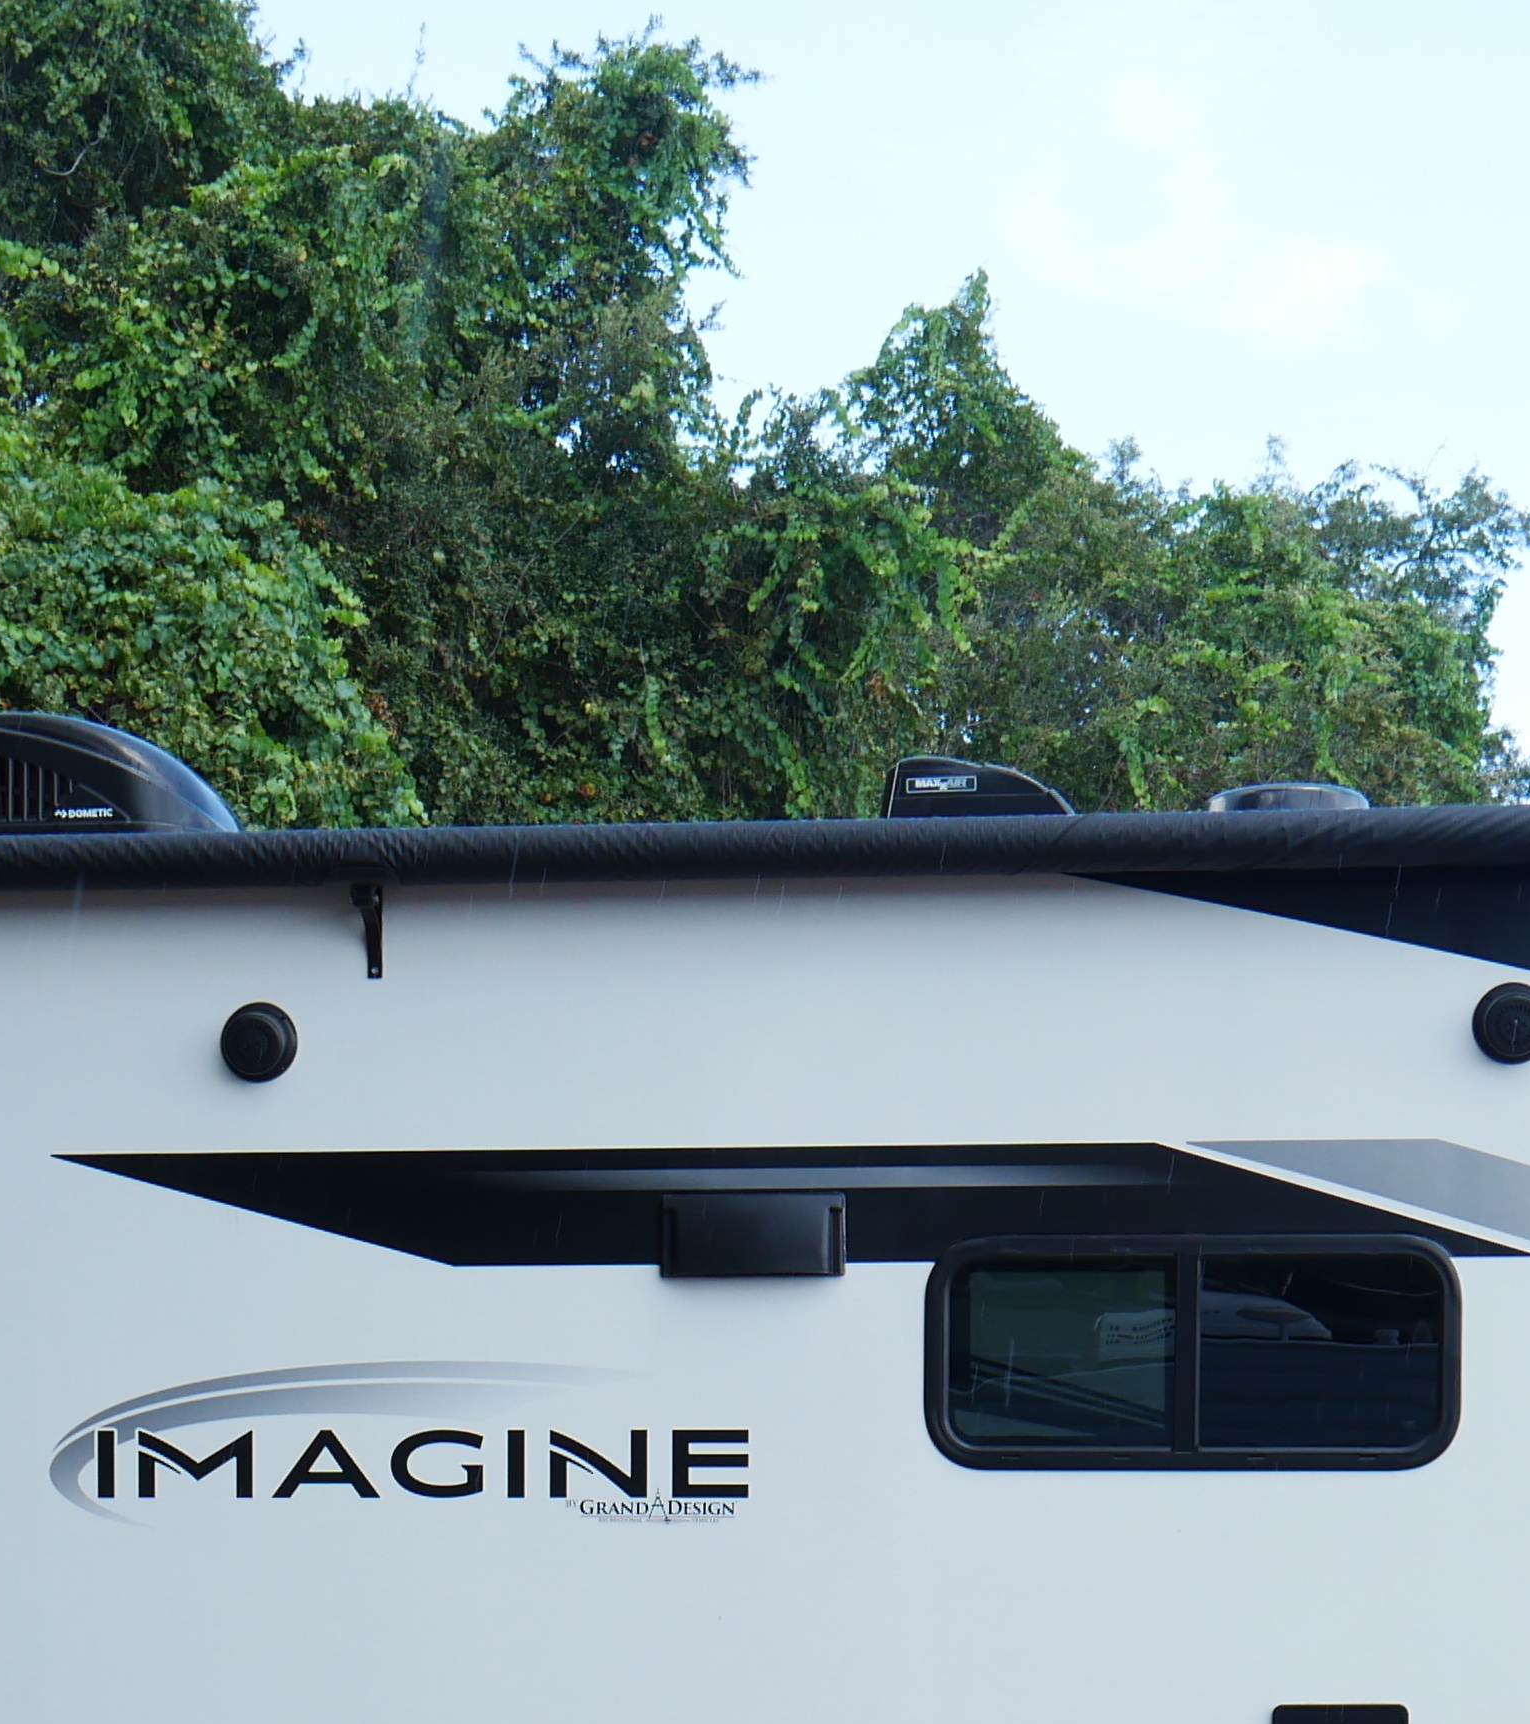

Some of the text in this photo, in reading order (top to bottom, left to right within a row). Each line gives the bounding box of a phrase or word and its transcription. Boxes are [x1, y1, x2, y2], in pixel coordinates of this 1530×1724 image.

[68, 807, 114, 820] DOMETIC
[93, 1427, 750, 1499] IMAGINE
[579, 1499, 649, 1516] GRAND
[668, 1499, 736, 1516] DESIGN
